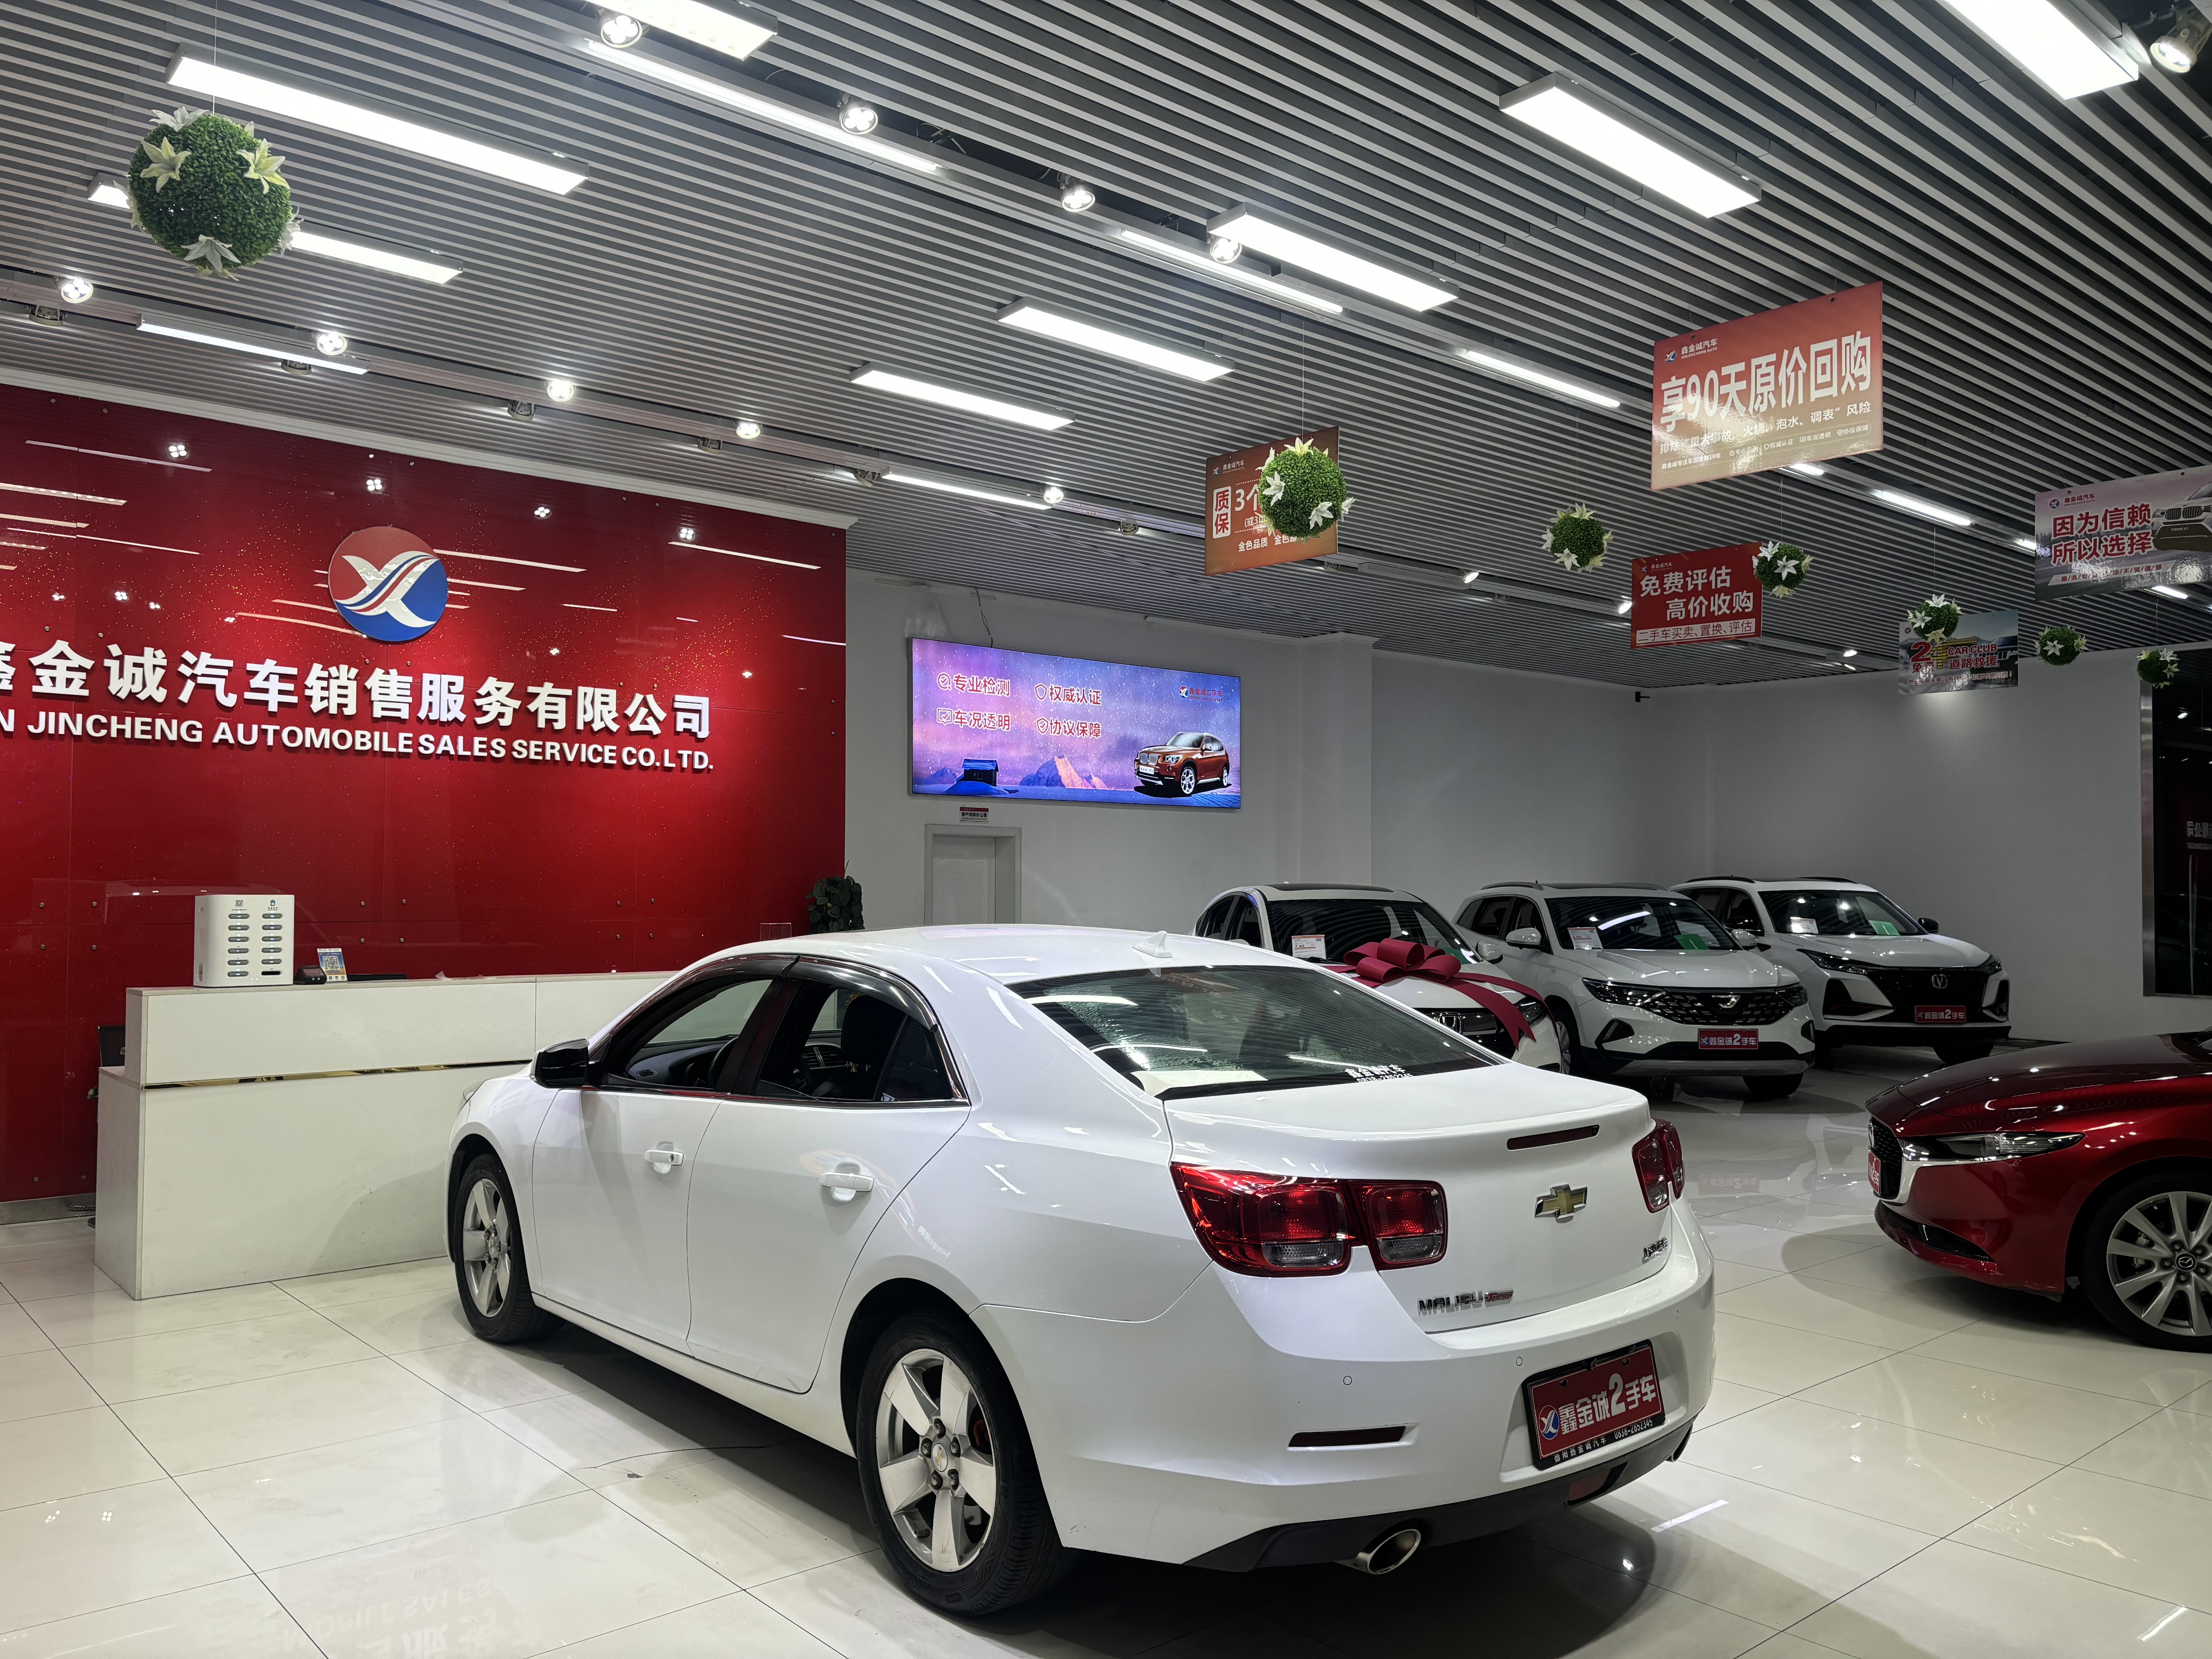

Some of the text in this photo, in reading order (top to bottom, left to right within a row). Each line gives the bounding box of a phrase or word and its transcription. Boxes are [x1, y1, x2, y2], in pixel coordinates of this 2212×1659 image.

[1681, 338, 1717, 355] 鑫金诚汽车
[1660, 331, 1871, 433] 享90天原价回购
[1806, 431, 1831, 441] 车况透明
[1843, 424, 1868, 435] 协议保障
[1215, 489, 1229, 535] 质保
[2053, 503, 2151, 538] 因为信赖
[1238, 537, 1267, 552] 金色品质
[2052, 531, 2152, 565] 所以选择
[1640, 566, 1731, 597] 免费评估
[1666, 591, 1753, 621] 高价收购
[1638, 621, 1752, 642] 二手车买卖、置换、评估
[1948, 644, 1997, 655] CAR CLUB
[1949, 655, 1997, 670] 道路救援
[0, 639, 710, 739] 金诚汽车销售服务有限公司
[953, 674, 1011, 697] 专业检测
[1049, 685, 1102, 706] 权威认证
[953, 709, 1011, 732] 车况透明
[1049, 719, 1102, 738] 协议保障
[27, 711, 203, 742] JINCHENG
[212, 722, 413, 753] AUTOMOBILE
[417, 734, 506, 759] SALES
[512, 739, 617, 764] SERVICE
[1558, 1373, 1656, 1435] 鑫金诚2手车
[1614, 1419, 1653, 1439] 0838-2852345
